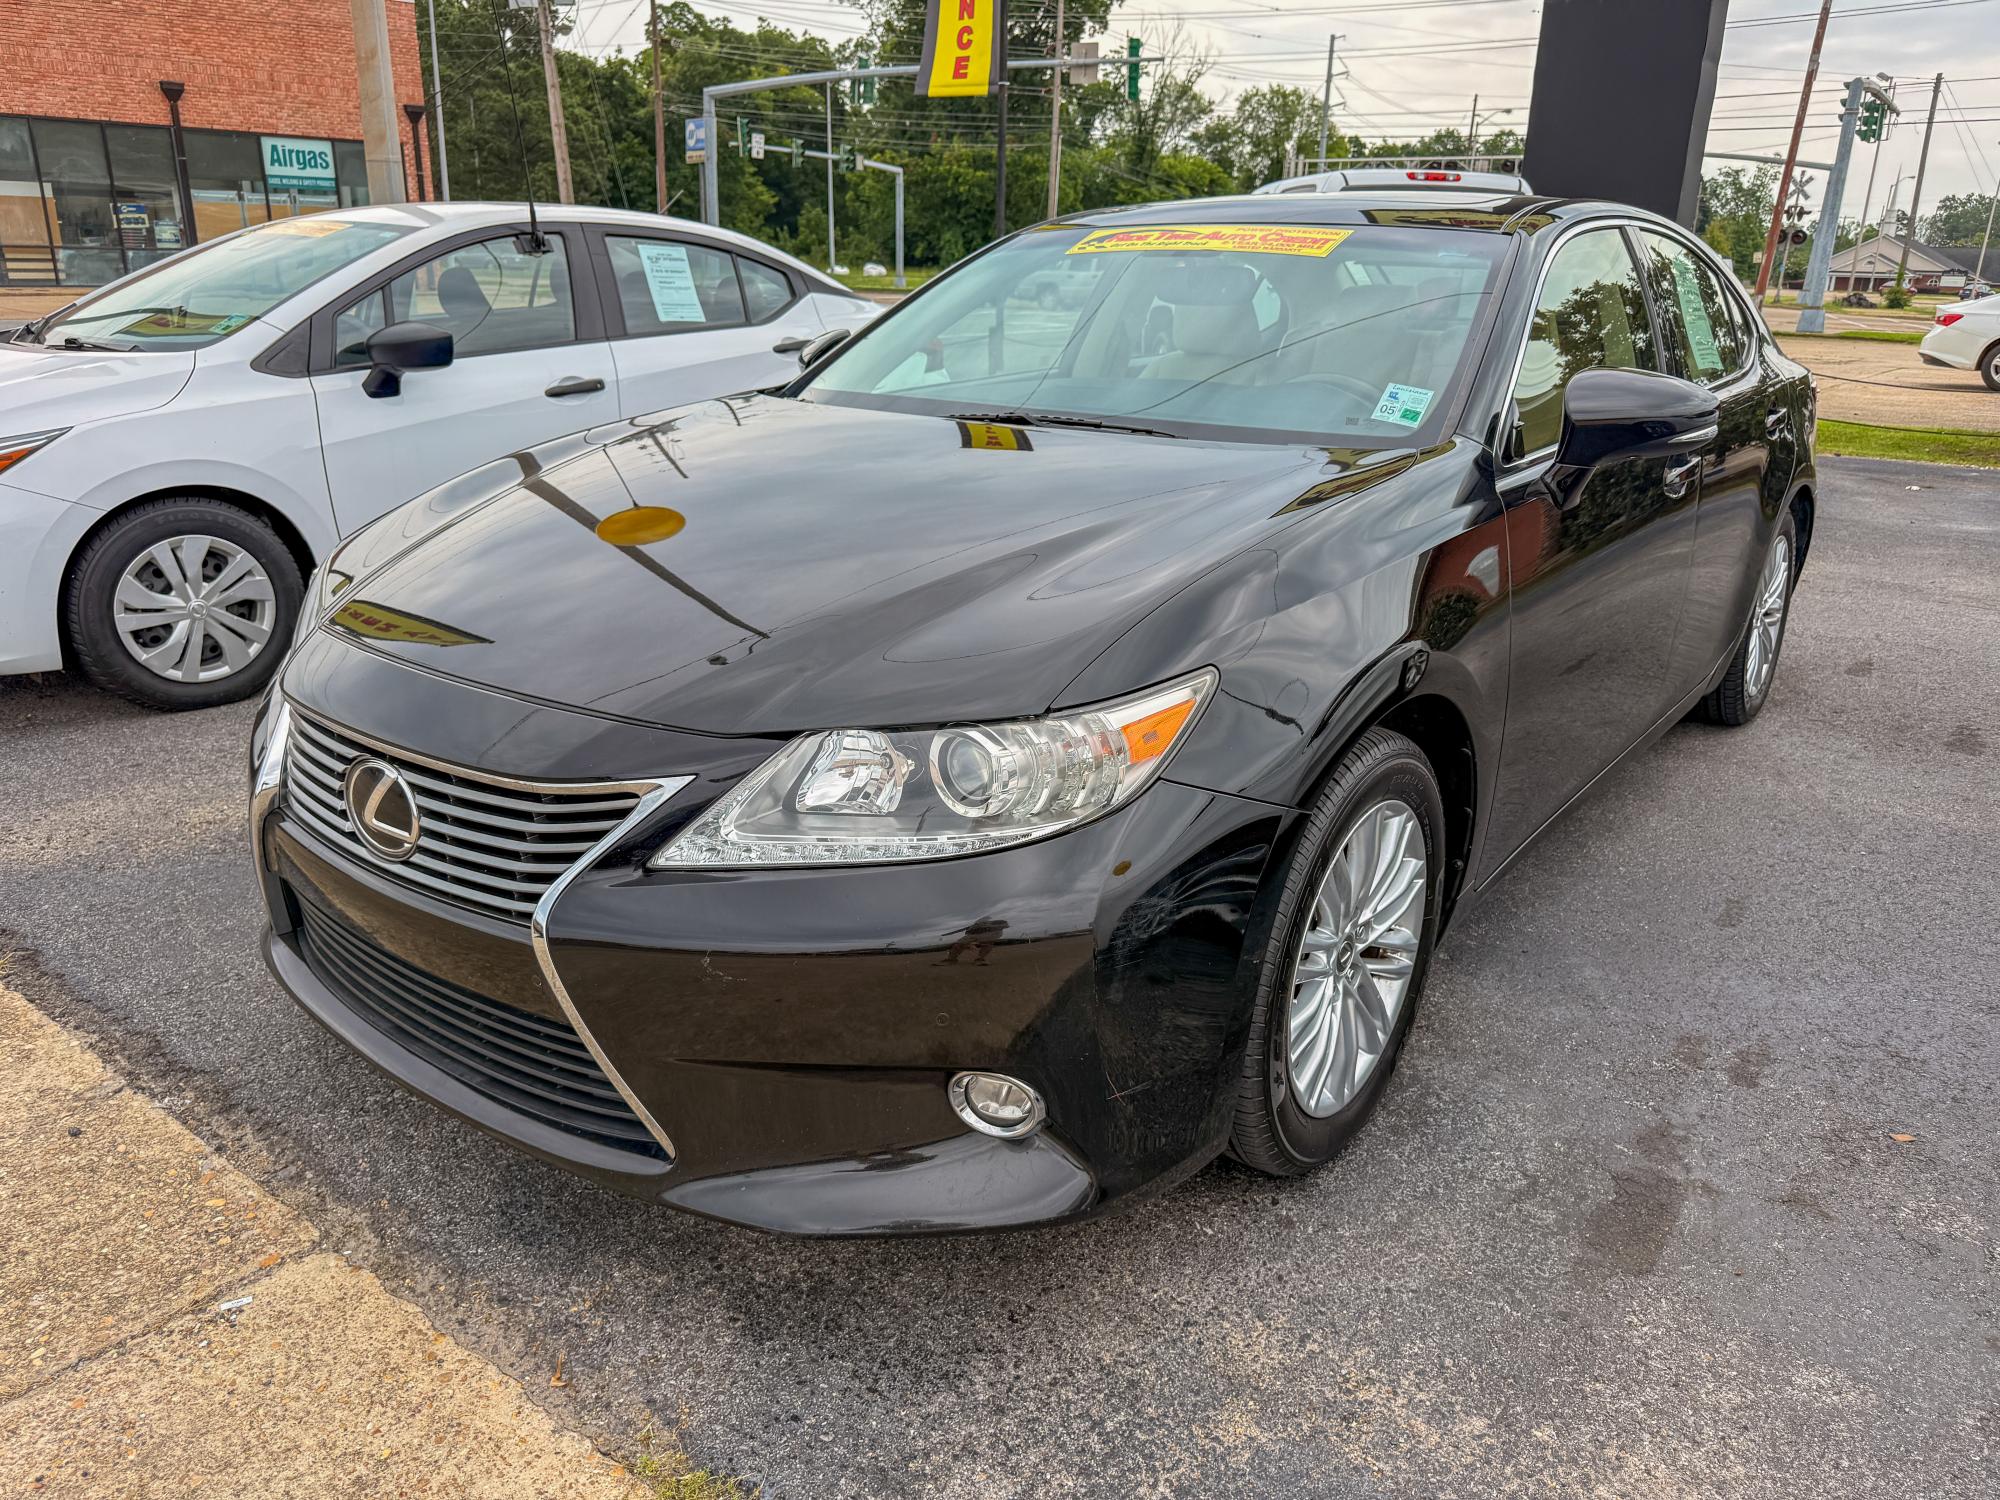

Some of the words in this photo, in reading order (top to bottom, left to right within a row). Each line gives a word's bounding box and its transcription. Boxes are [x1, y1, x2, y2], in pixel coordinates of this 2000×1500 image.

[952, 0, 976, 80] NCE
[270, 144, 330, 171] Airgas
[1380, 404, 1397, 415] 05
